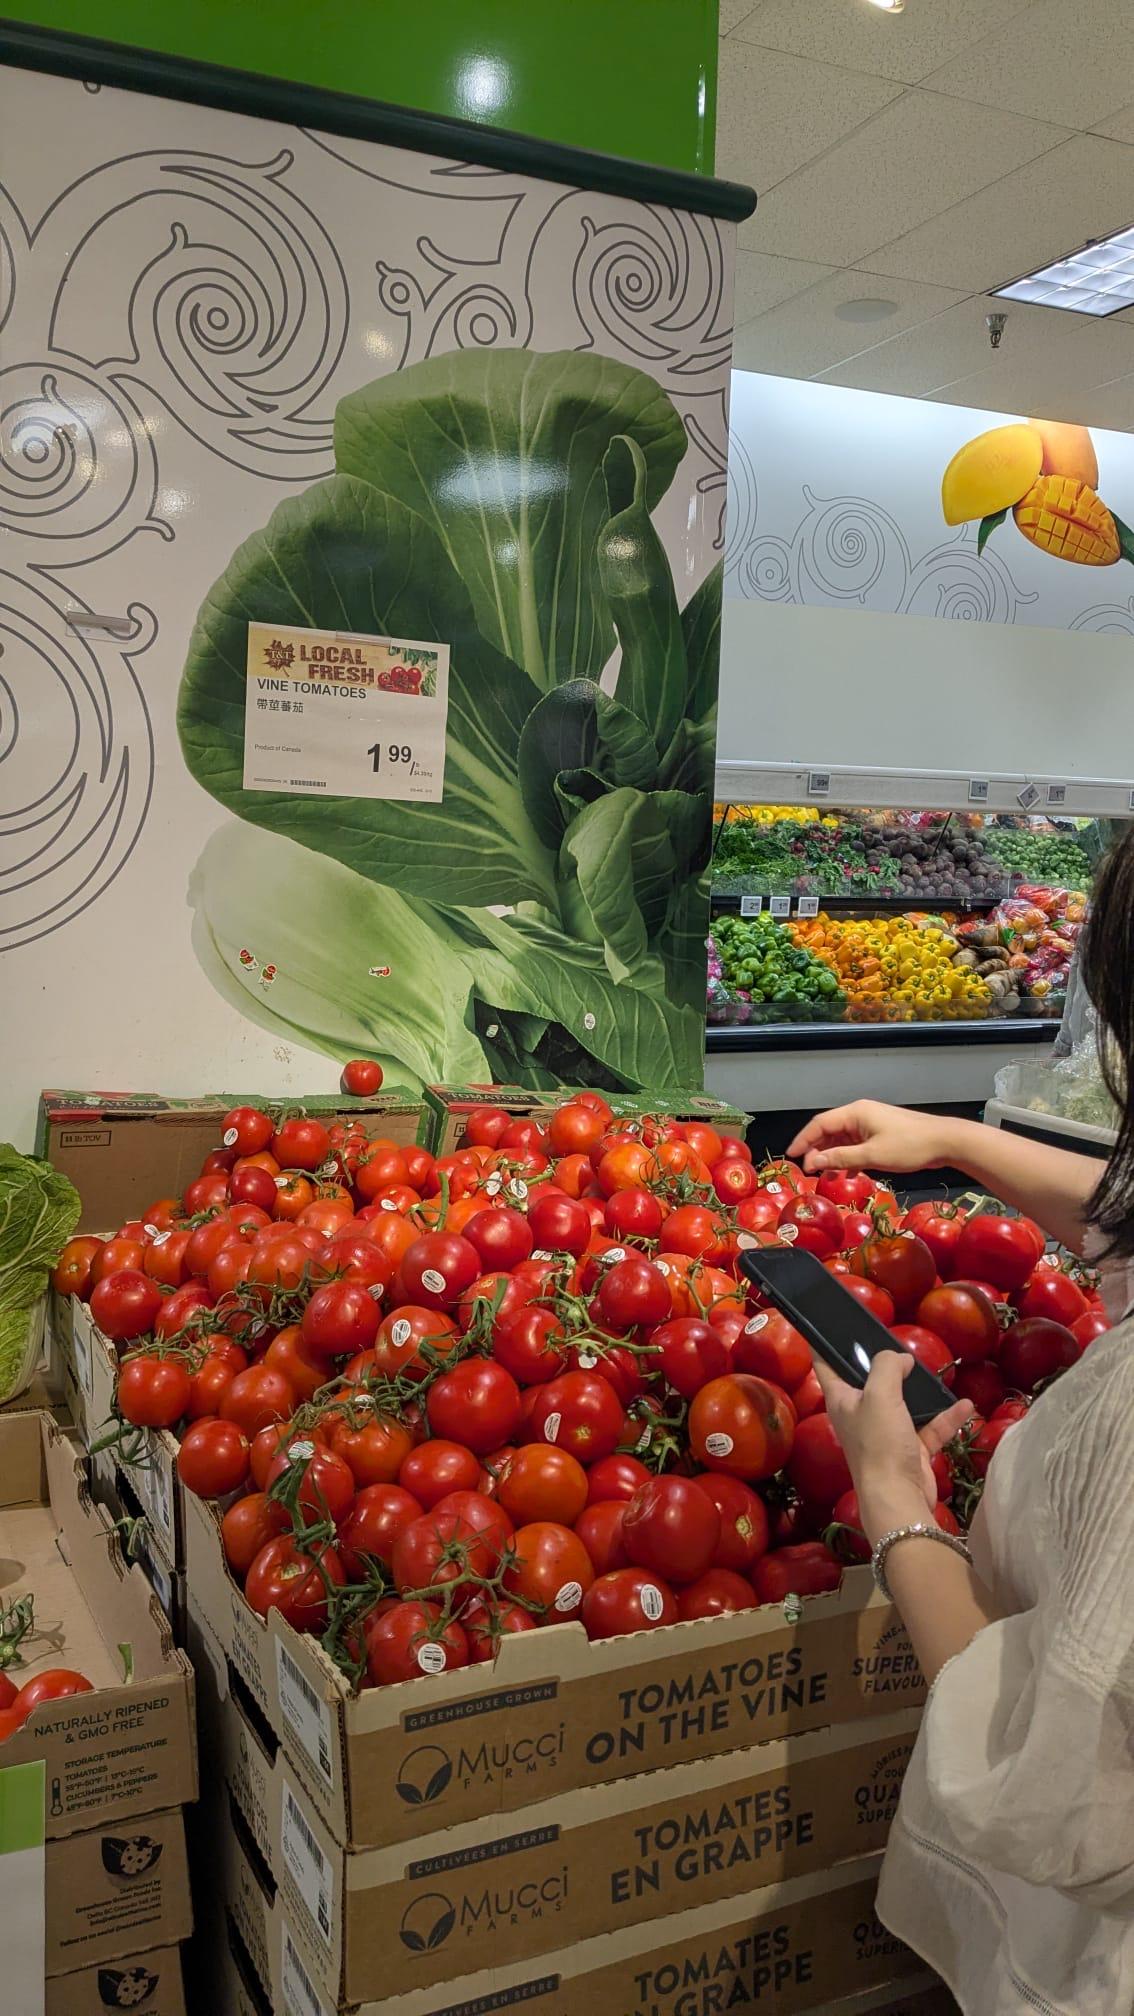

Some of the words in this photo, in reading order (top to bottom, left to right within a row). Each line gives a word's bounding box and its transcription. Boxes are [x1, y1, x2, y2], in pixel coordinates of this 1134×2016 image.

[270, 650, 292, 660] T&T
[300, 644, 367, 665] LOCAL
[257, 678, 289, 692] VINE
[293, 681, 367, 699] TOMATOES
[308, 663, 375, 684] FRESH
[254, 743, 275, 751] Product
[446, 1092, 531, 1102] TOMATOES
[850, 1654, 920, 1677] SUPERI
[617, 1647, 803, 1720] TOMATOES
[34, 1710, 113, 1738] NATURALLY
[115, 1698, 170, 1718] RIPENED
[410, 1697, 501, 1727] GREENHOUSE
[505, 1688, 552, 1704] GROWN
[584, 1720, 646, 1765] ON
[658, 1698, 730, 1745] THE
[740, 1671, 829, 1721] VINE
[64, 1733, 75, 1744] &
[78, 1724, 110, 1741] GMO
[112, 1716, 145, 1733] FREE
[64, 1753, 105, 1770] STORAGE
[106, 1738, 168, 1759] TEMPERATURE
[65, 1765, 108, 1781] TOMATOES
[463, 1755, 558, 1790] FARMS
[66, 1783, 115, 1802] CUCUMBERS
[634, 1785, 792, 1858] TOMATES
[492, 1842, 508, 1855] EN
[513, 1829, 553, 1849] SERRE
[610, 1859, 661, 1905] EN
[674, 1811, 815, 1882] GRAPPE
[466, 1899, 562, 1937] FARMS
[634, 1925, 792, 2002] TOMATES
[674, 1951, 814, 2016] GRAPPE
